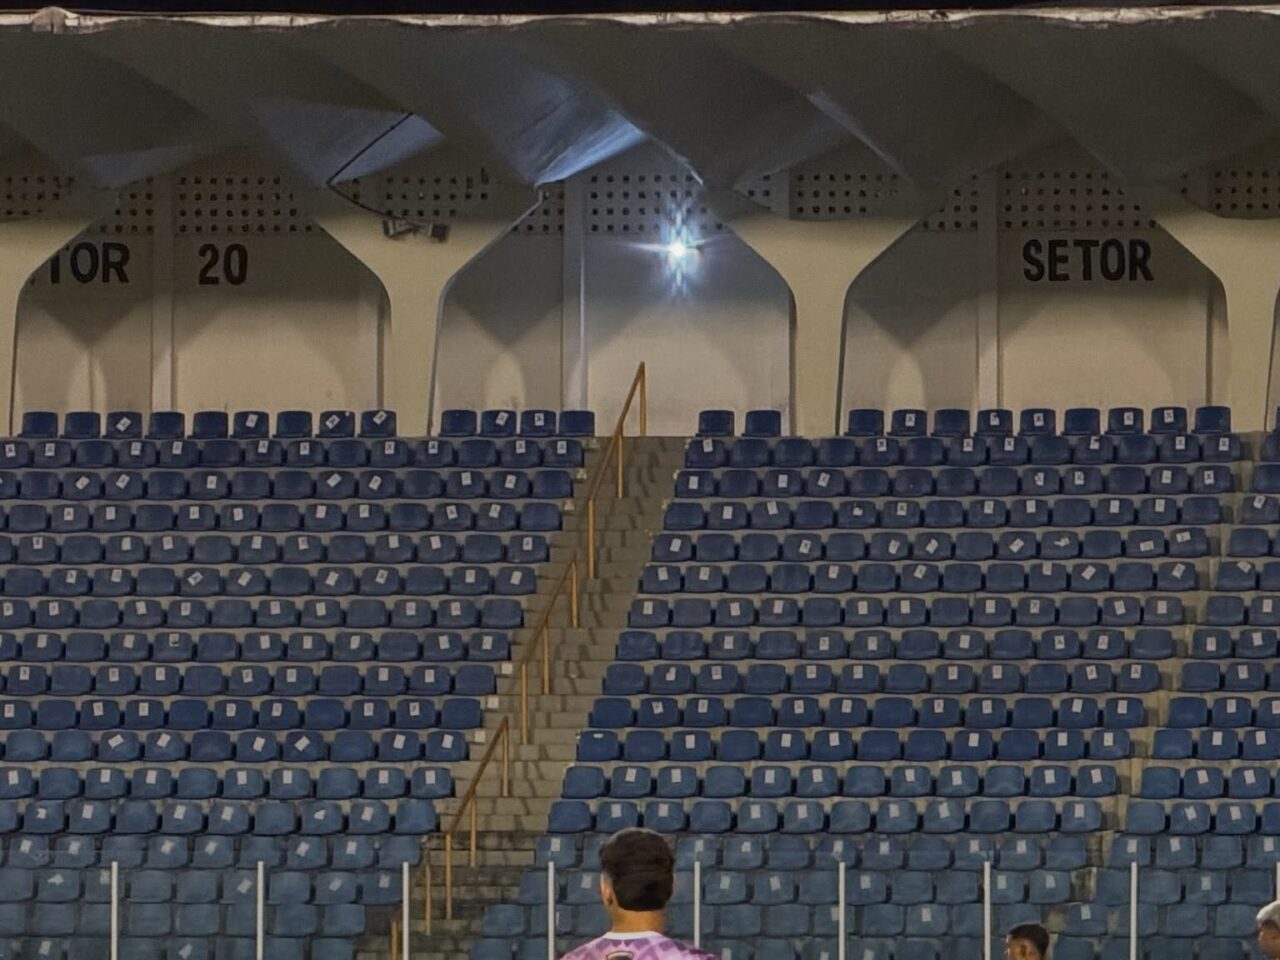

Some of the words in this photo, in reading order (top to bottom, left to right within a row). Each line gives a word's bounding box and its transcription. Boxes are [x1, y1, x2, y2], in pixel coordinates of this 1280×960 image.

[50, 241, 130, 284] TOR
[198, 243, 249, 285] 20
[1022, 238, 1155, 282] SETOR
